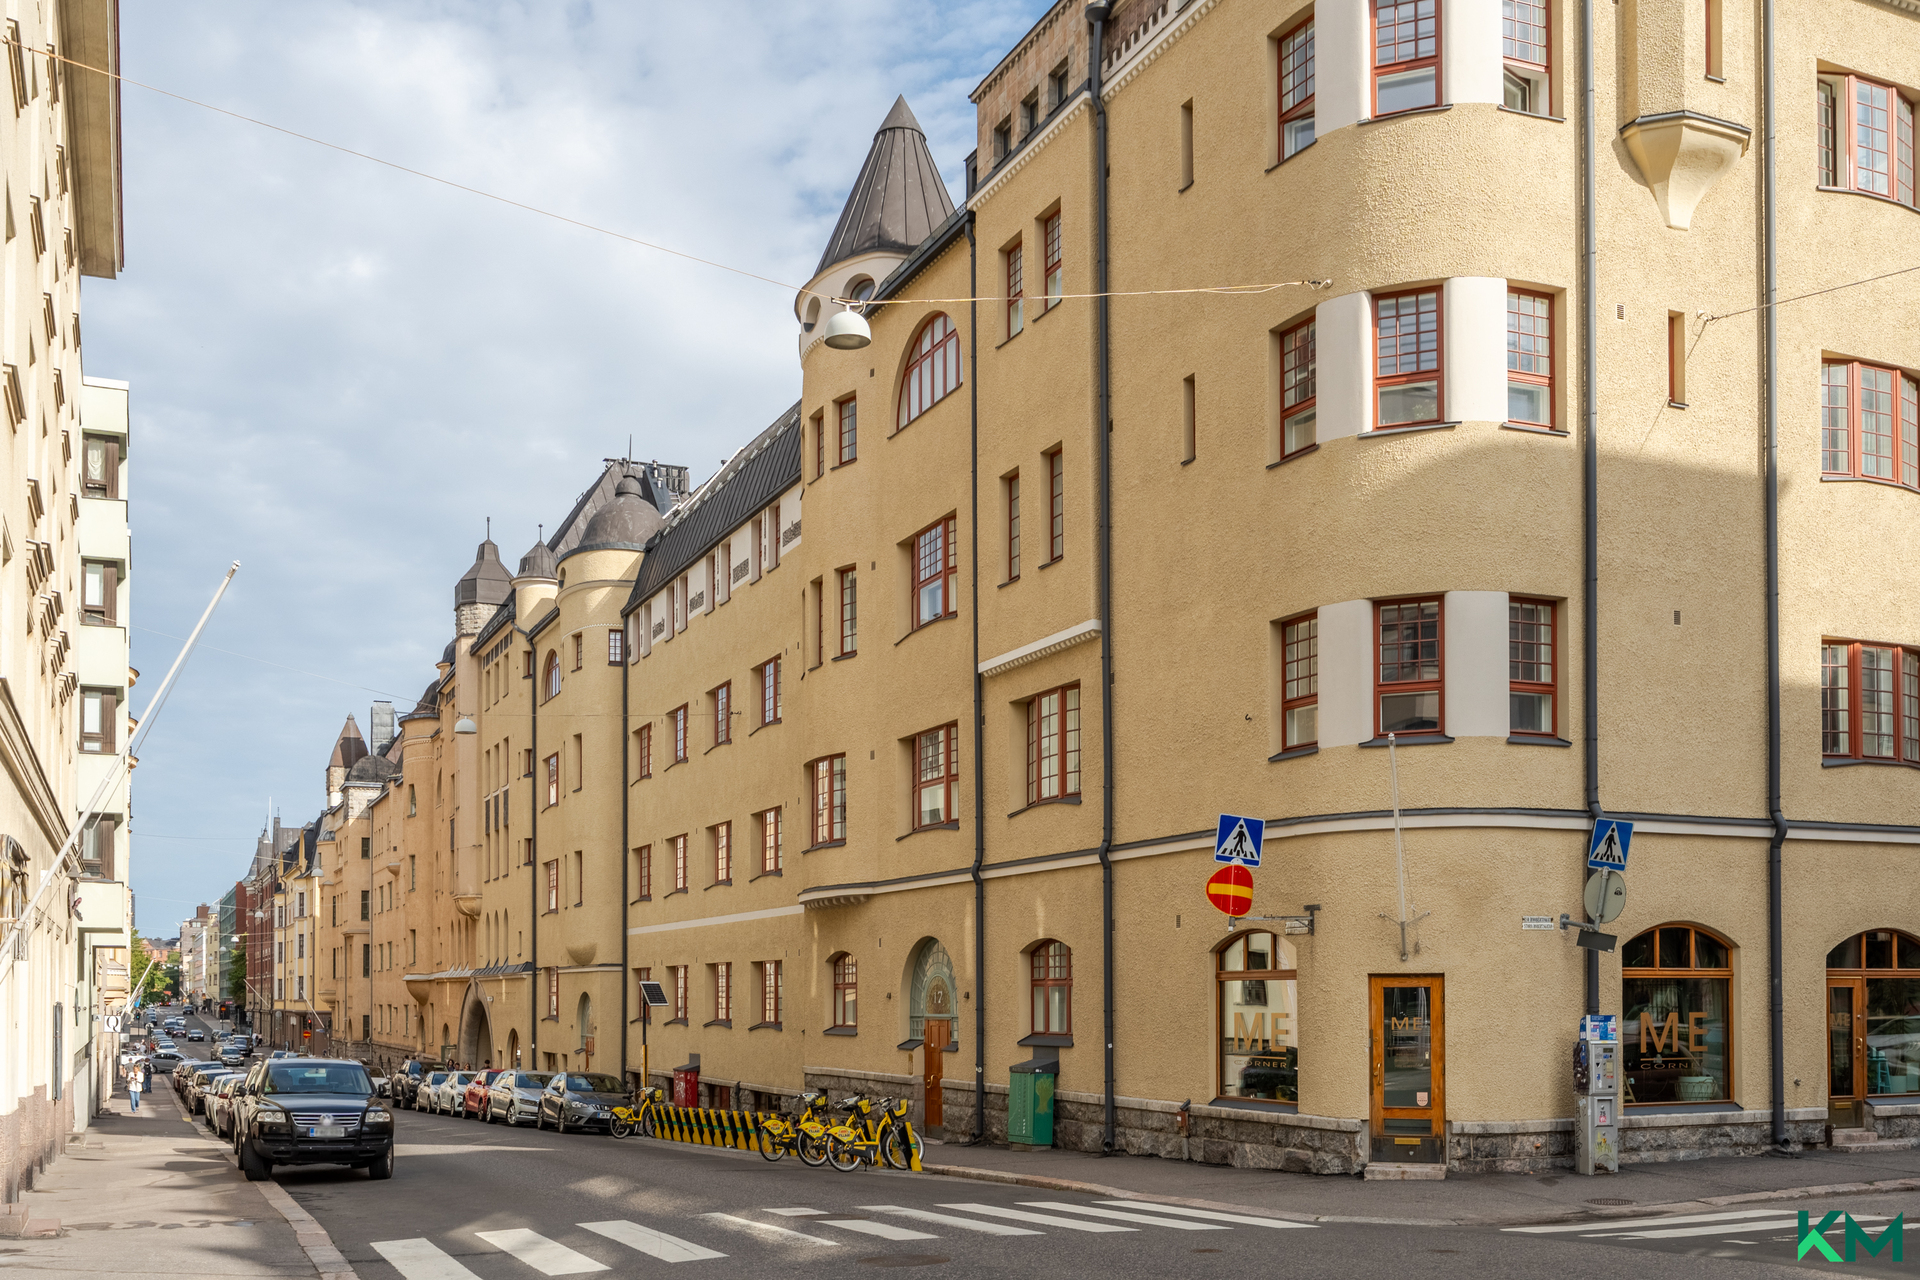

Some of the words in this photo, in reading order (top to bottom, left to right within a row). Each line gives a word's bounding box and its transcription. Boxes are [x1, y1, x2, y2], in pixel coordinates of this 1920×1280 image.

[933, 990, 943, 1004] 17
[106, 1015, 119, 1032] Q
[1391, 1016, 1423, 1030] ME
[1234, 1012, 1287, 1052] ME
[1641, 1012, 1708, 1053] ME
[1233, 1059, 1288, 1069] CORNER
